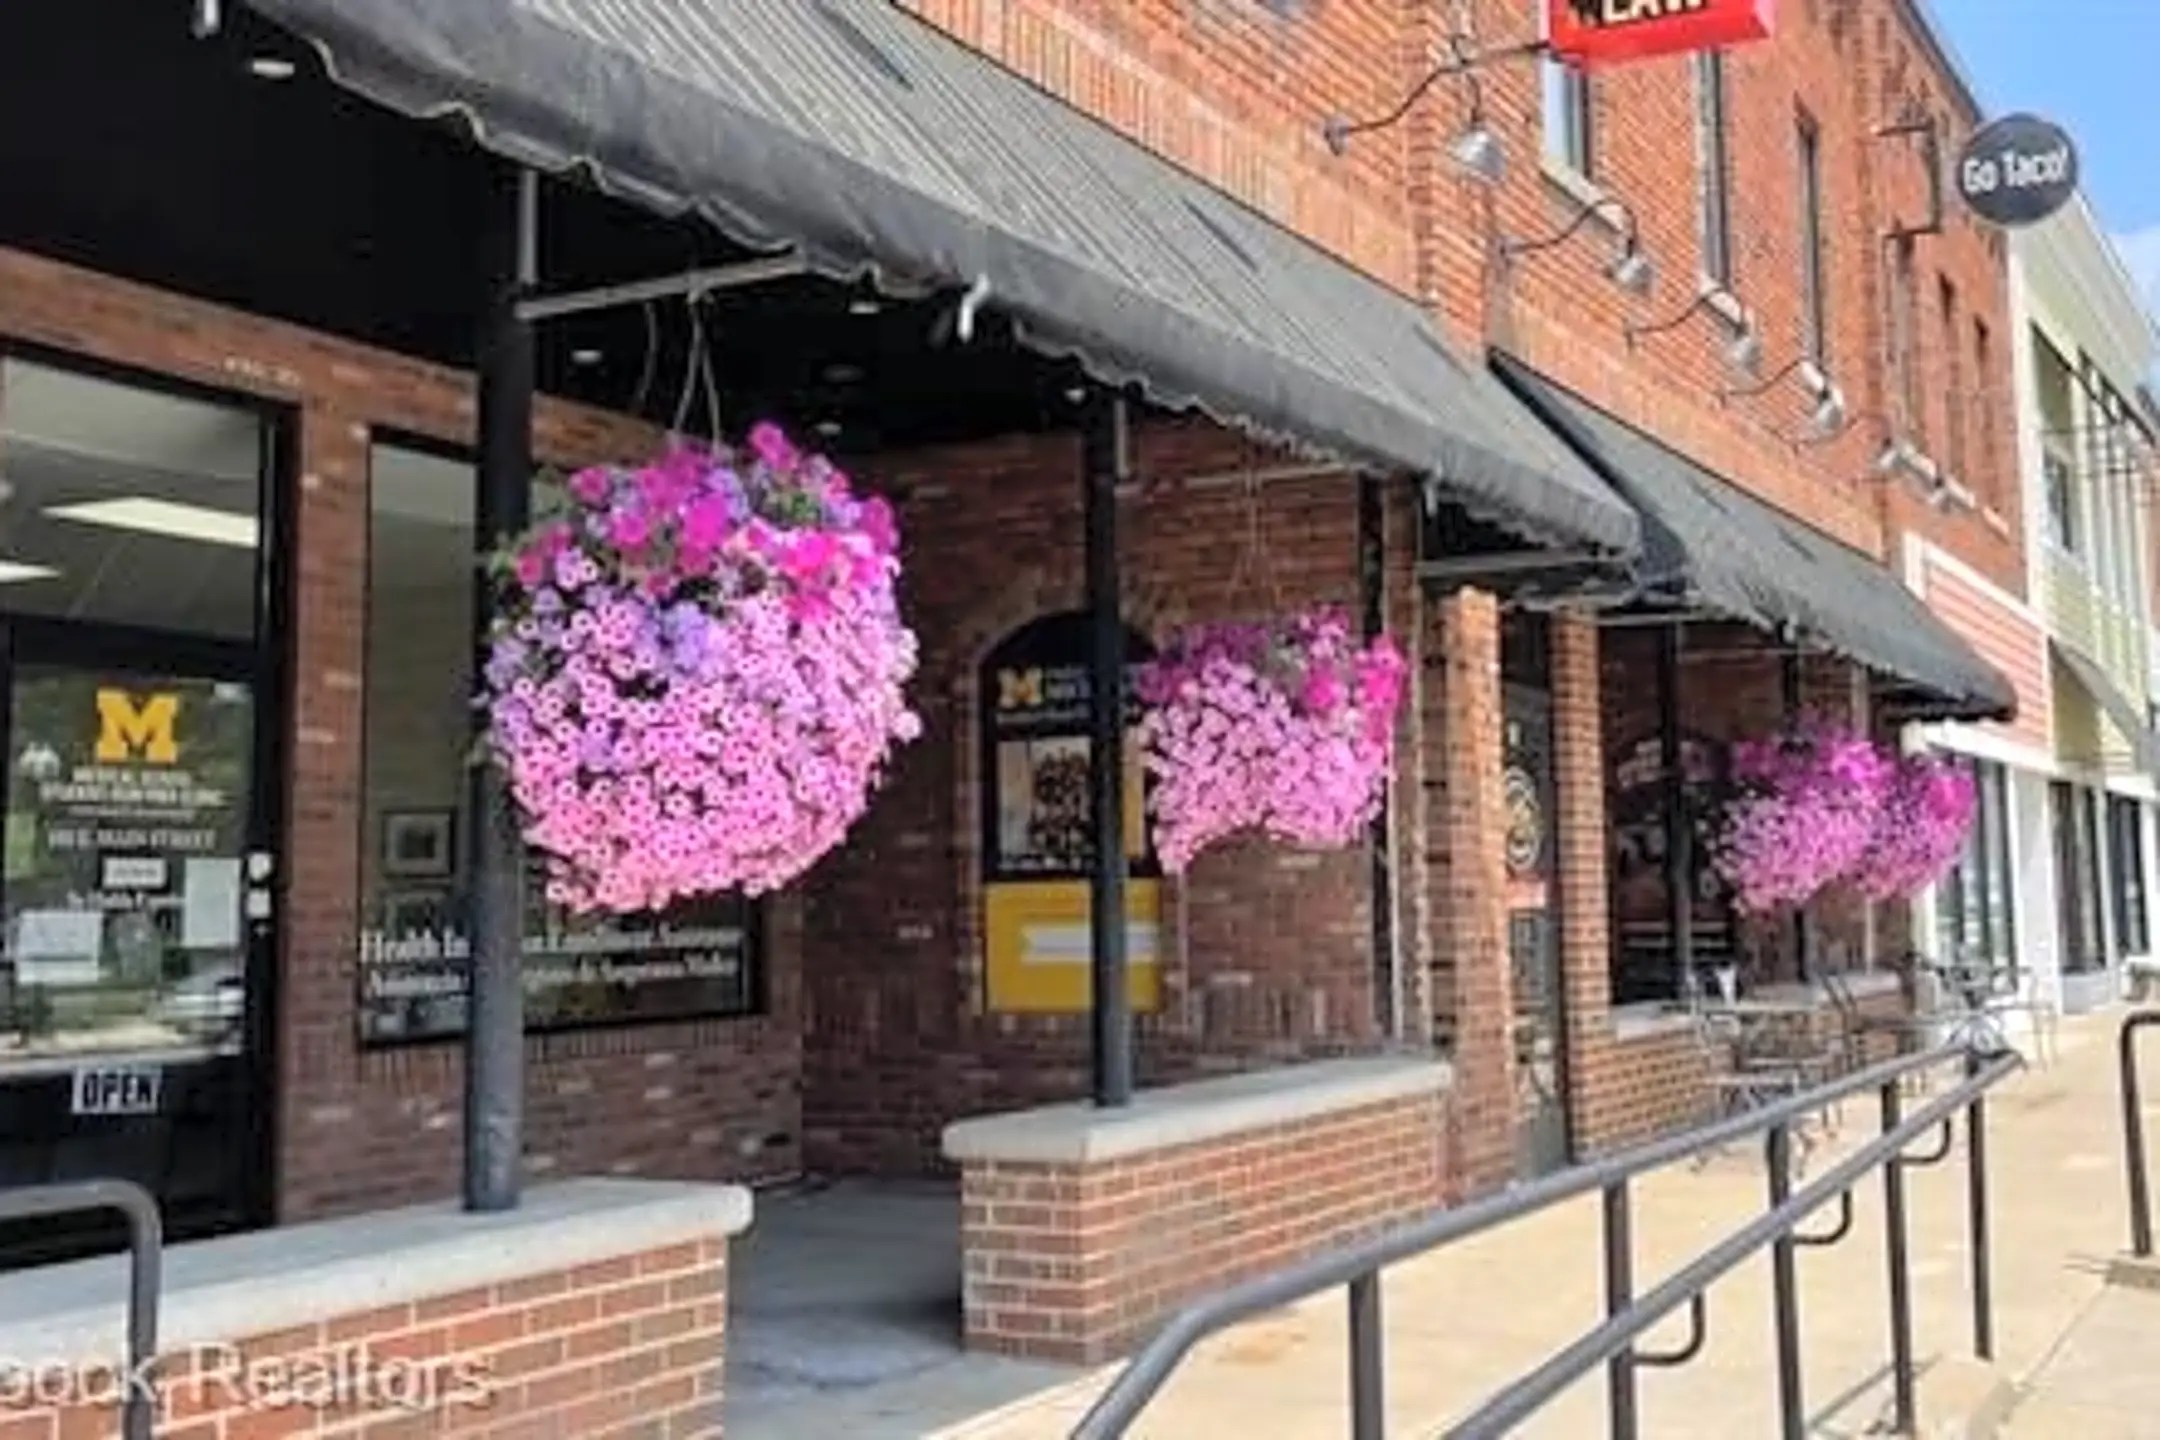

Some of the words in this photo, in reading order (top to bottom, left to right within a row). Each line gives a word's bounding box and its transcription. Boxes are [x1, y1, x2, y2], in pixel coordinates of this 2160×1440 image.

[1963, 158, 1998, 196] Go
[2002, 145, 2068, 188] Taco!
[97, 688, 177, 763] M
[81, 1067, 159, 1108] OPEN
